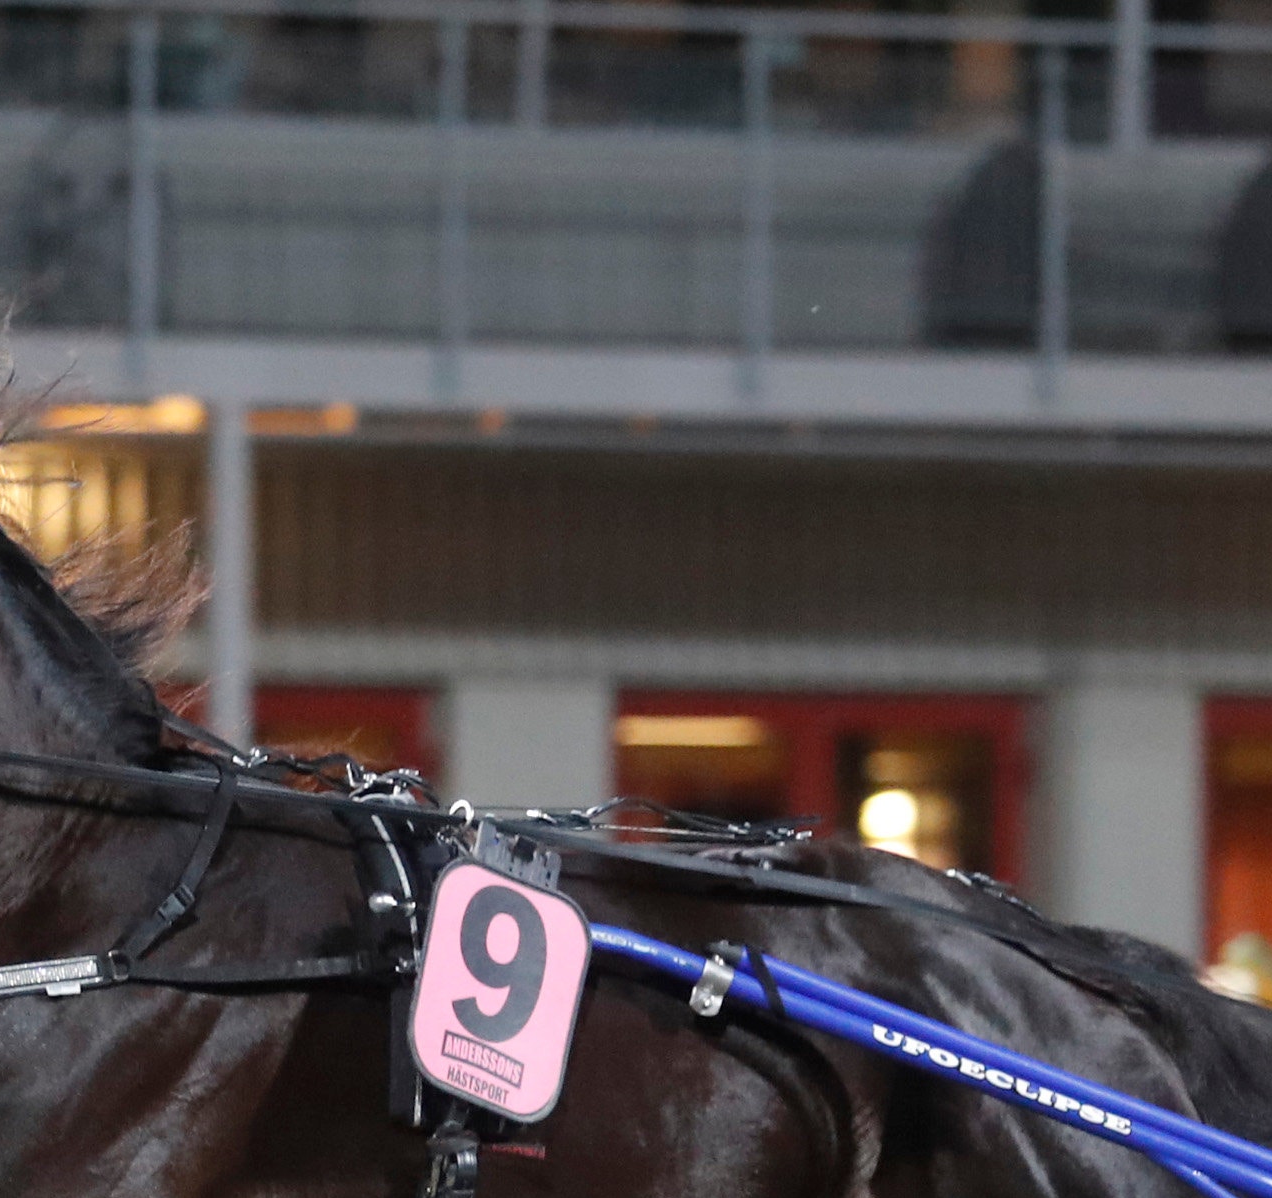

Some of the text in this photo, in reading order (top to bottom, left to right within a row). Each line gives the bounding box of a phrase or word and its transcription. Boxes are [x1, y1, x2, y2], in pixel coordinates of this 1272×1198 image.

[452, 885, 547, 1043] 9
[443, 1032, 521, 1086] ANDERSSONS
[447, 1064, 509, 1104] HÄSTSPORT
[872, 1023, 1131, 1135] UFOECLIPSE
